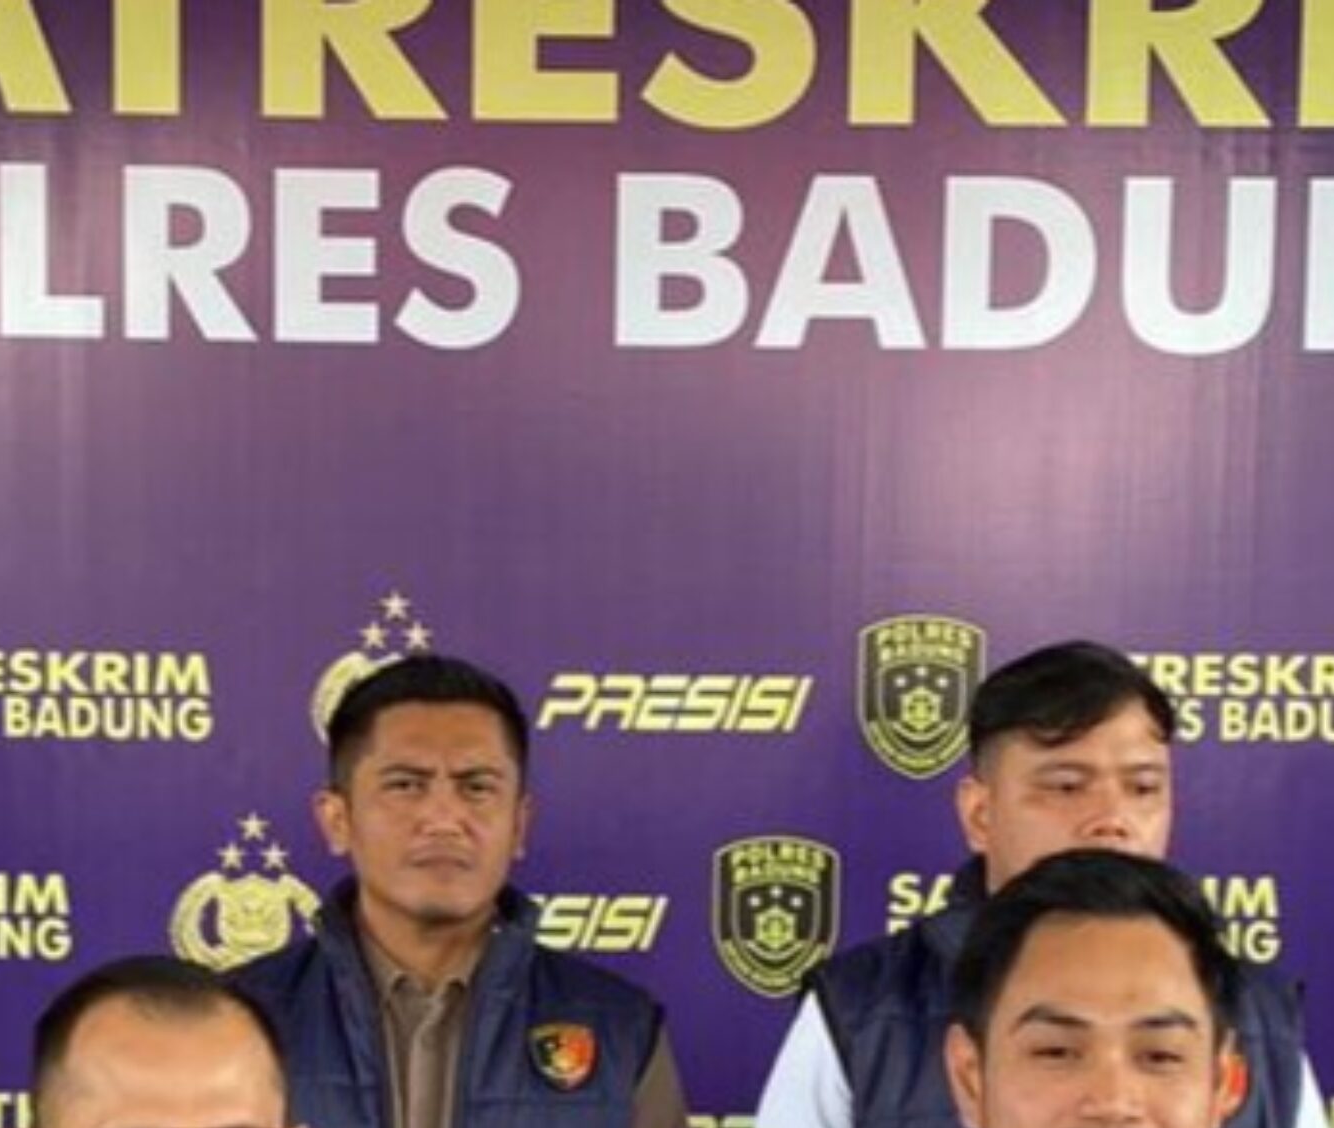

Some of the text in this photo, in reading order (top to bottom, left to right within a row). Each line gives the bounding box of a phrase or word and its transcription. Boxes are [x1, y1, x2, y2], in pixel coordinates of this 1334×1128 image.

[4, 695, 213, 741] BADUNG
[536, 674, 813, 732] PRESISI
[529, 893, 670, 950] SISI
